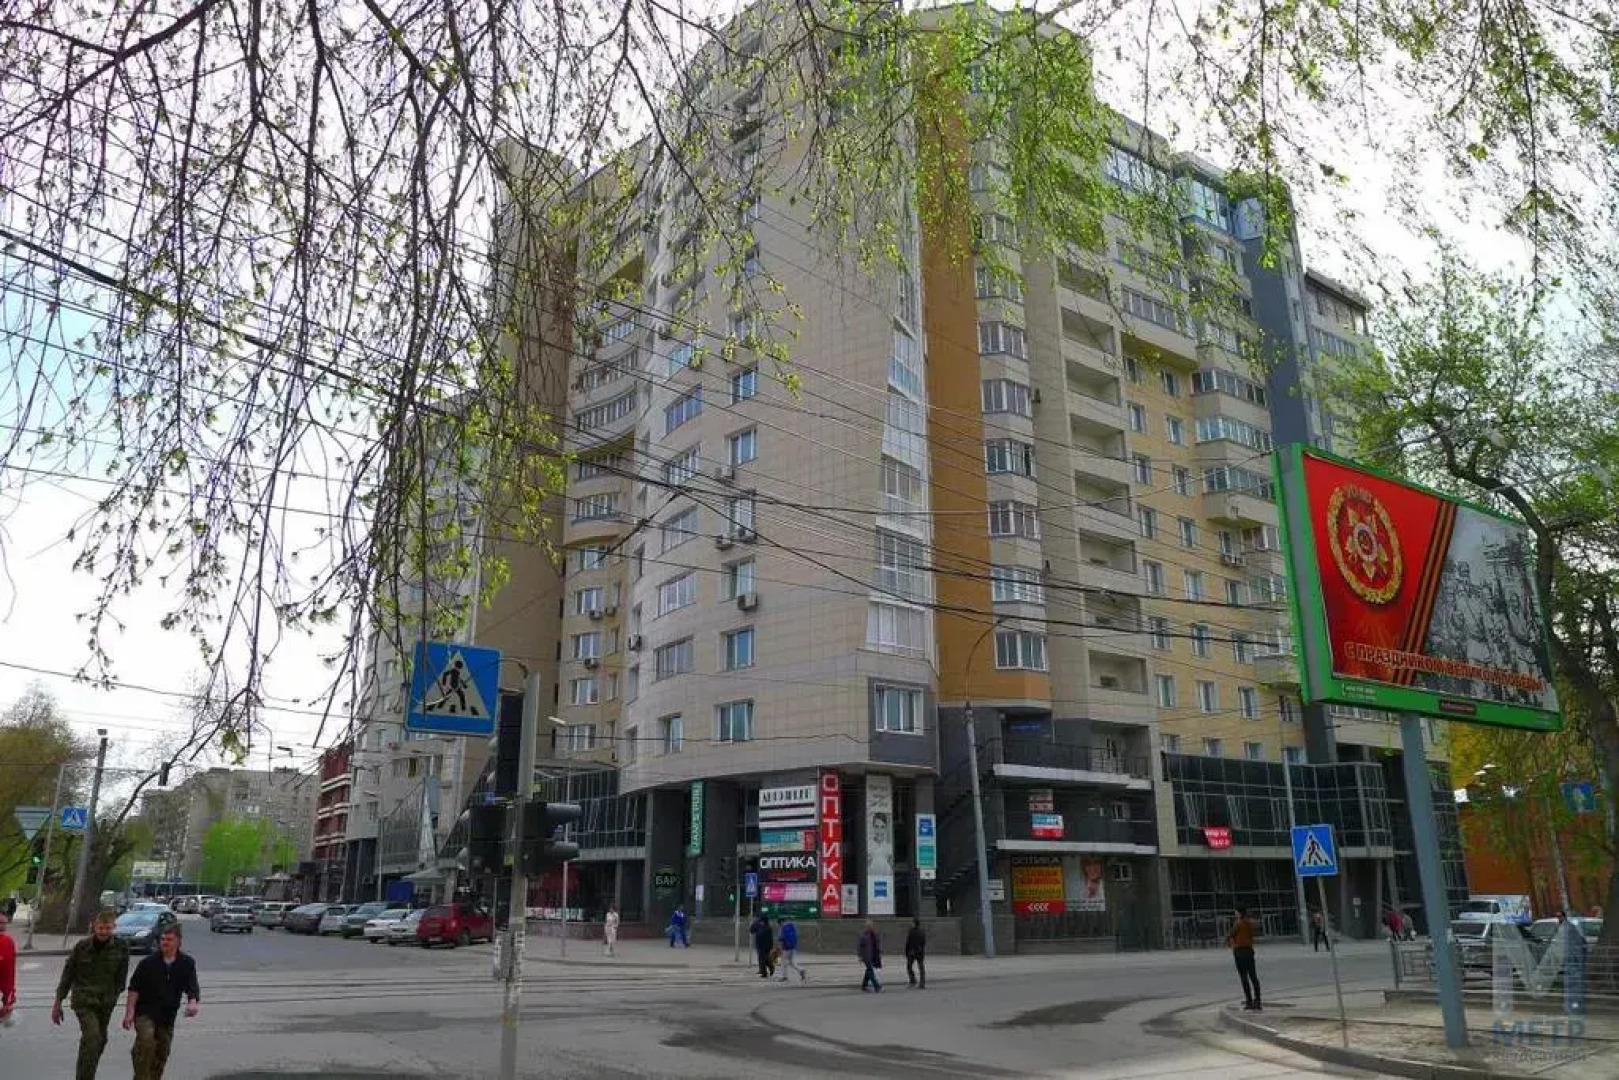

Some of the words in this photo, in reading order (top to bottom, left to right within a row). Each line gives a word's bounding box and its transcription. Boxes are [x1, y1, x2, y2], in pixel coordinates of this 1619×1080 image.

[822, 774, 840, 900] ОПТИКА
[760, 856, 816, 869] ОПТИКА
[656, 875, 677, 885] БАР
